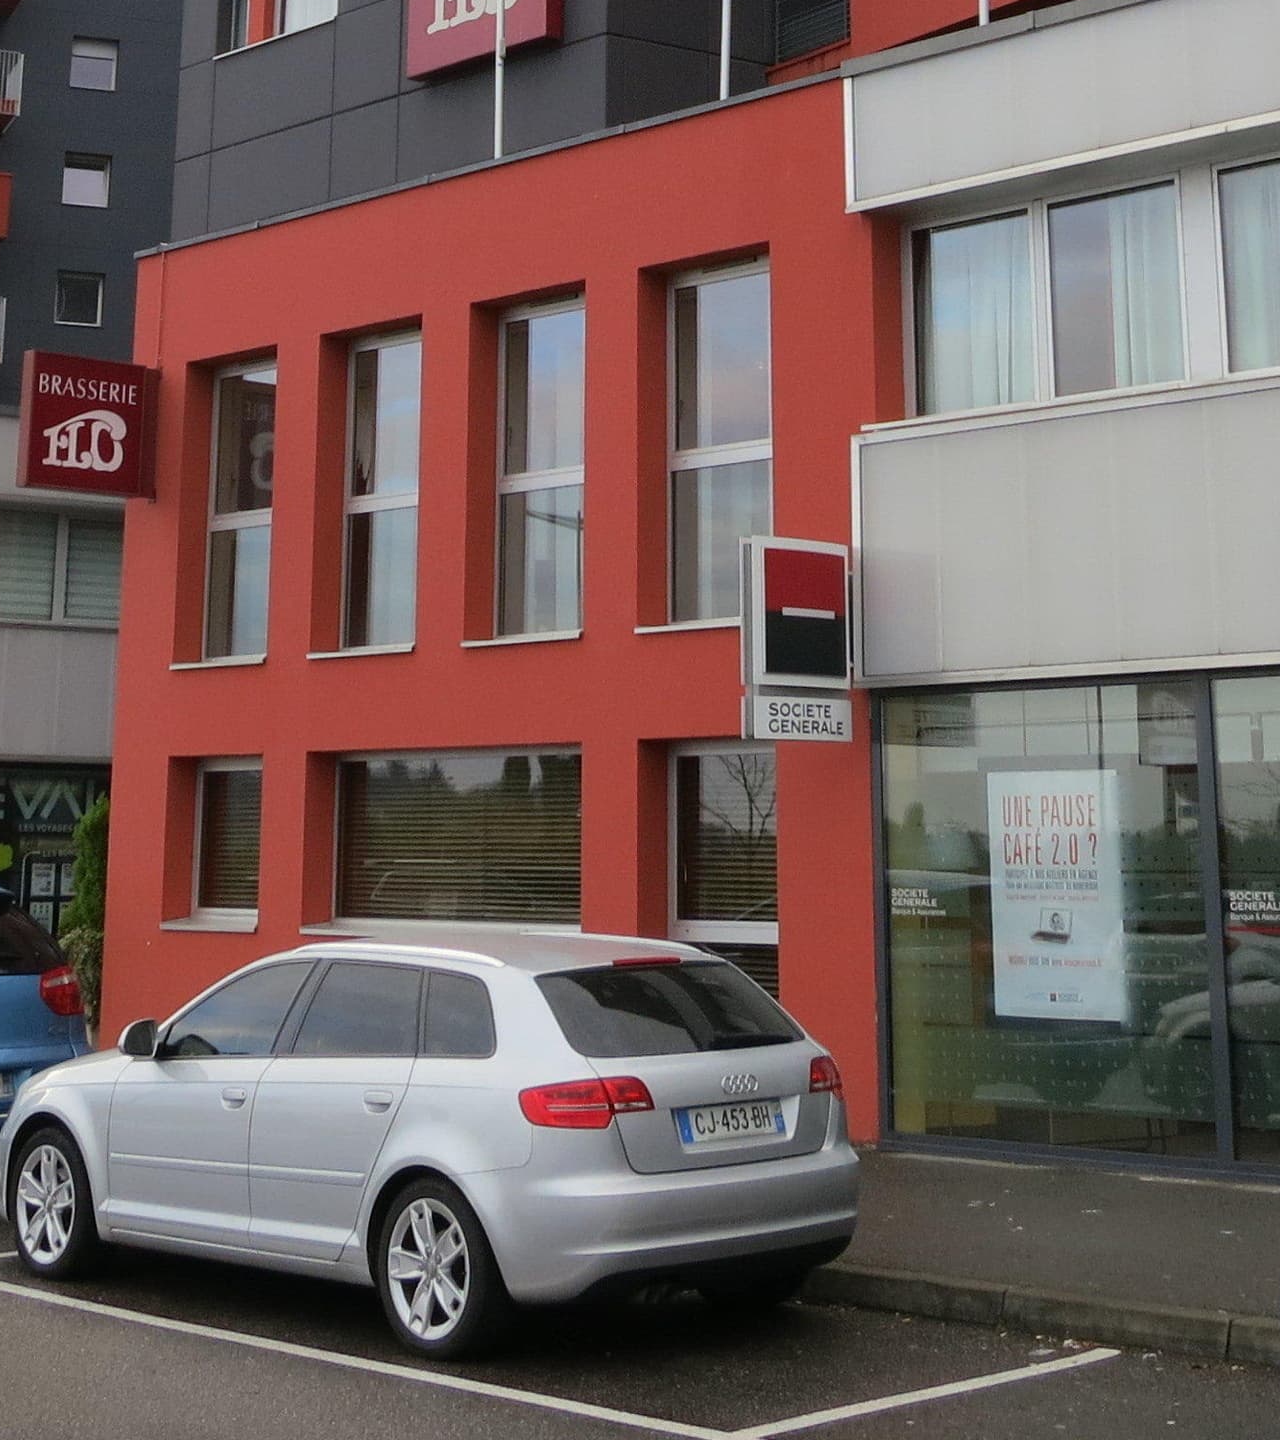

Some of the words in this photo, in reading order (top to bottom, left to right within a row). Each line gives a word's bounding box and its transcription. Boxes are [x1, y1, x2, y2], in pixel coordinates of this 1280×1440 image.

[38, 372, 138, 406] BRASSERIE
[41, 409, 127, 473] FLO
[768, 702, 832, 719] SOCIETE
[768, 718, 844, 736] GENERALE
[1002, 795, 1032, 828] UNE
[1041, 794, 1097, 828] PAUSE
[1003, 827, 1042, 865] CAFÉ
[1052, 832, 1079, 865] 2.0
[1088, 832, 1098, 865] ?
[891, 888, 928, 898] SOCIETE
[891, 898, 938, 908] GENERALE
[1229, 891, 1275, 901] SOCIETE
[694, 1106, 772, 1136] CJ-453-BH
